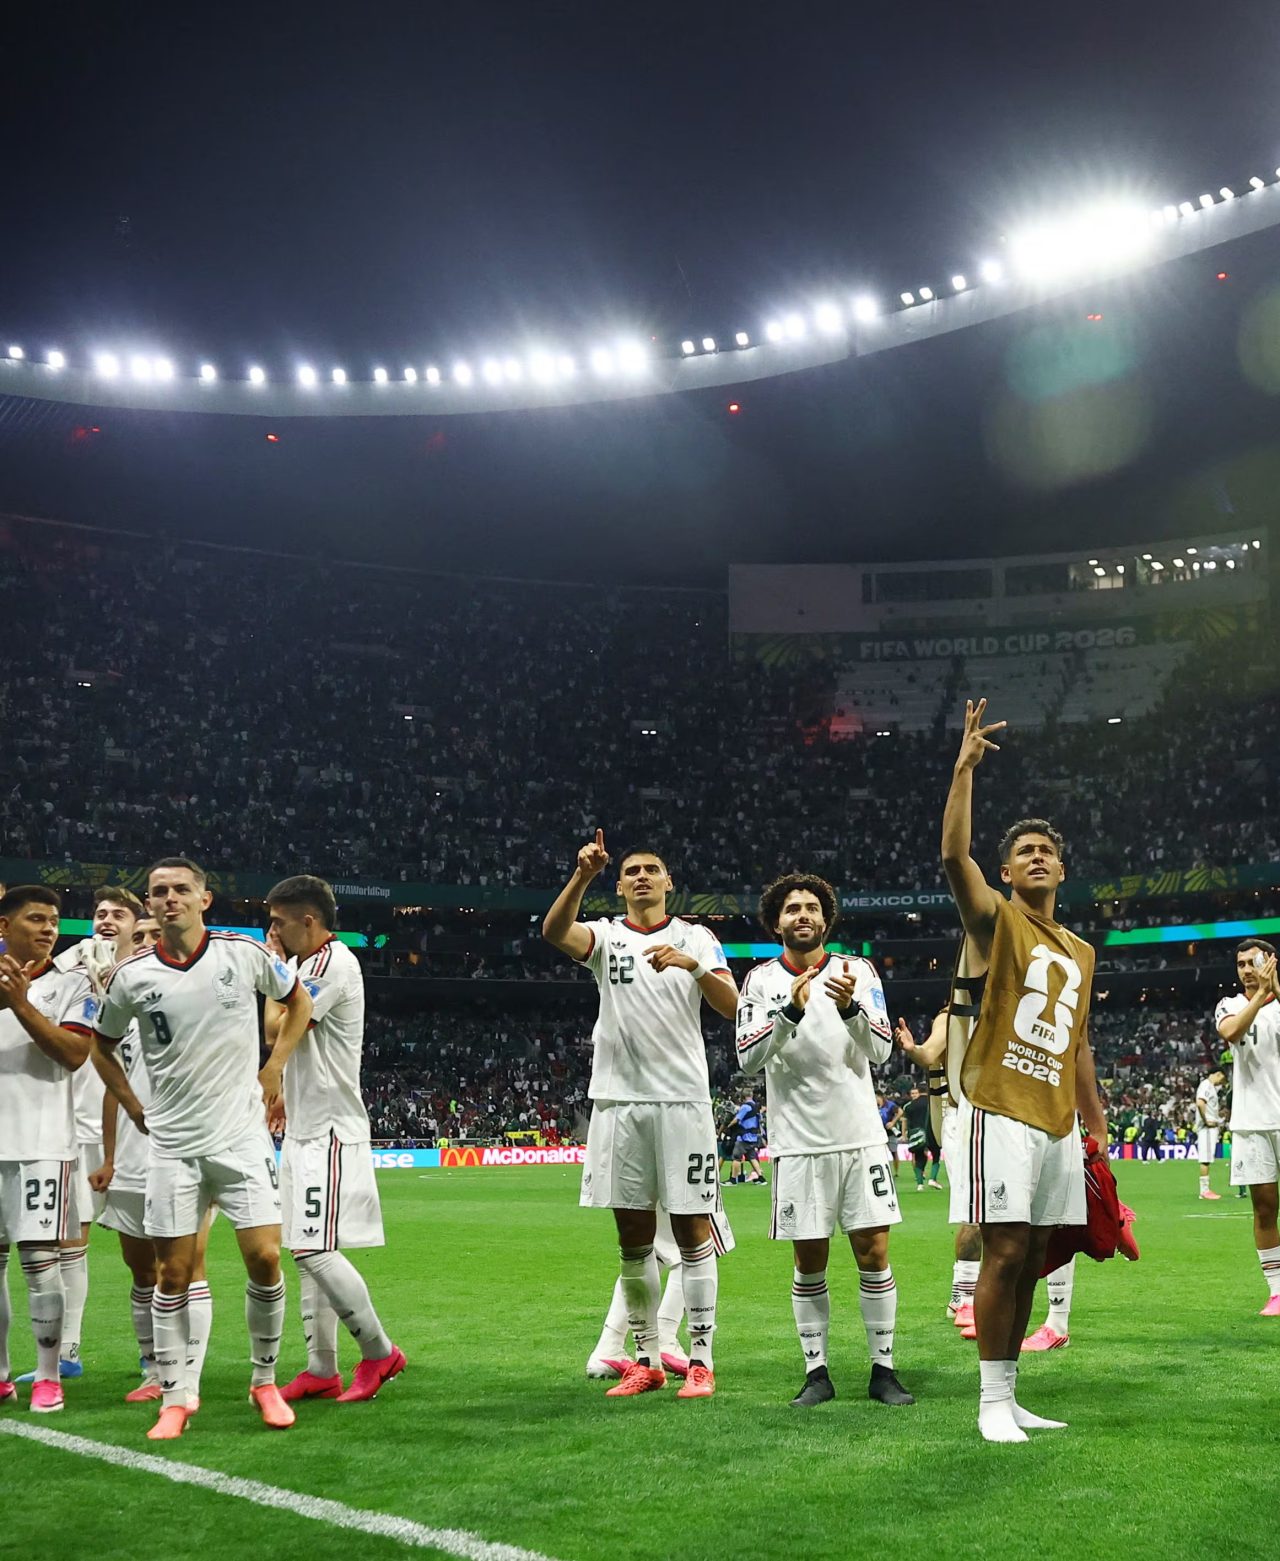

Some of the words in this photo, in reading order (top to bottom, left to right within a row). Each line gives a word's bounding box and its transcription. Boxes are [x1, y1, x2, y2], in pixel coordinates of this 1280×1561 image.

[860, 641, 910, 658] FIFA
[912, 635, 998, 656] WORLD
[1004, 633, 1050, 653] CUP
[1055, 626, 1136, 651] 2026
[842, 895, 914, 907] MEXICO
[609, 954, 634, 985] 22
[150, 1011, 172, 1045] 8
[1031, 1023, 1056, 1044] FIFA
[1001, 1052, 1061, 1087] 2026
[1008, 1040, 1047, 1063] WORLD
[1045, 1056, 1064, 1071] CUP
[482, 1149, 587, 1165] McDonald's
[687, 1153, 716, 1185] 22
[25, 1179, 57, 1211] 23
[305, 1187, 322, 1218] 5
